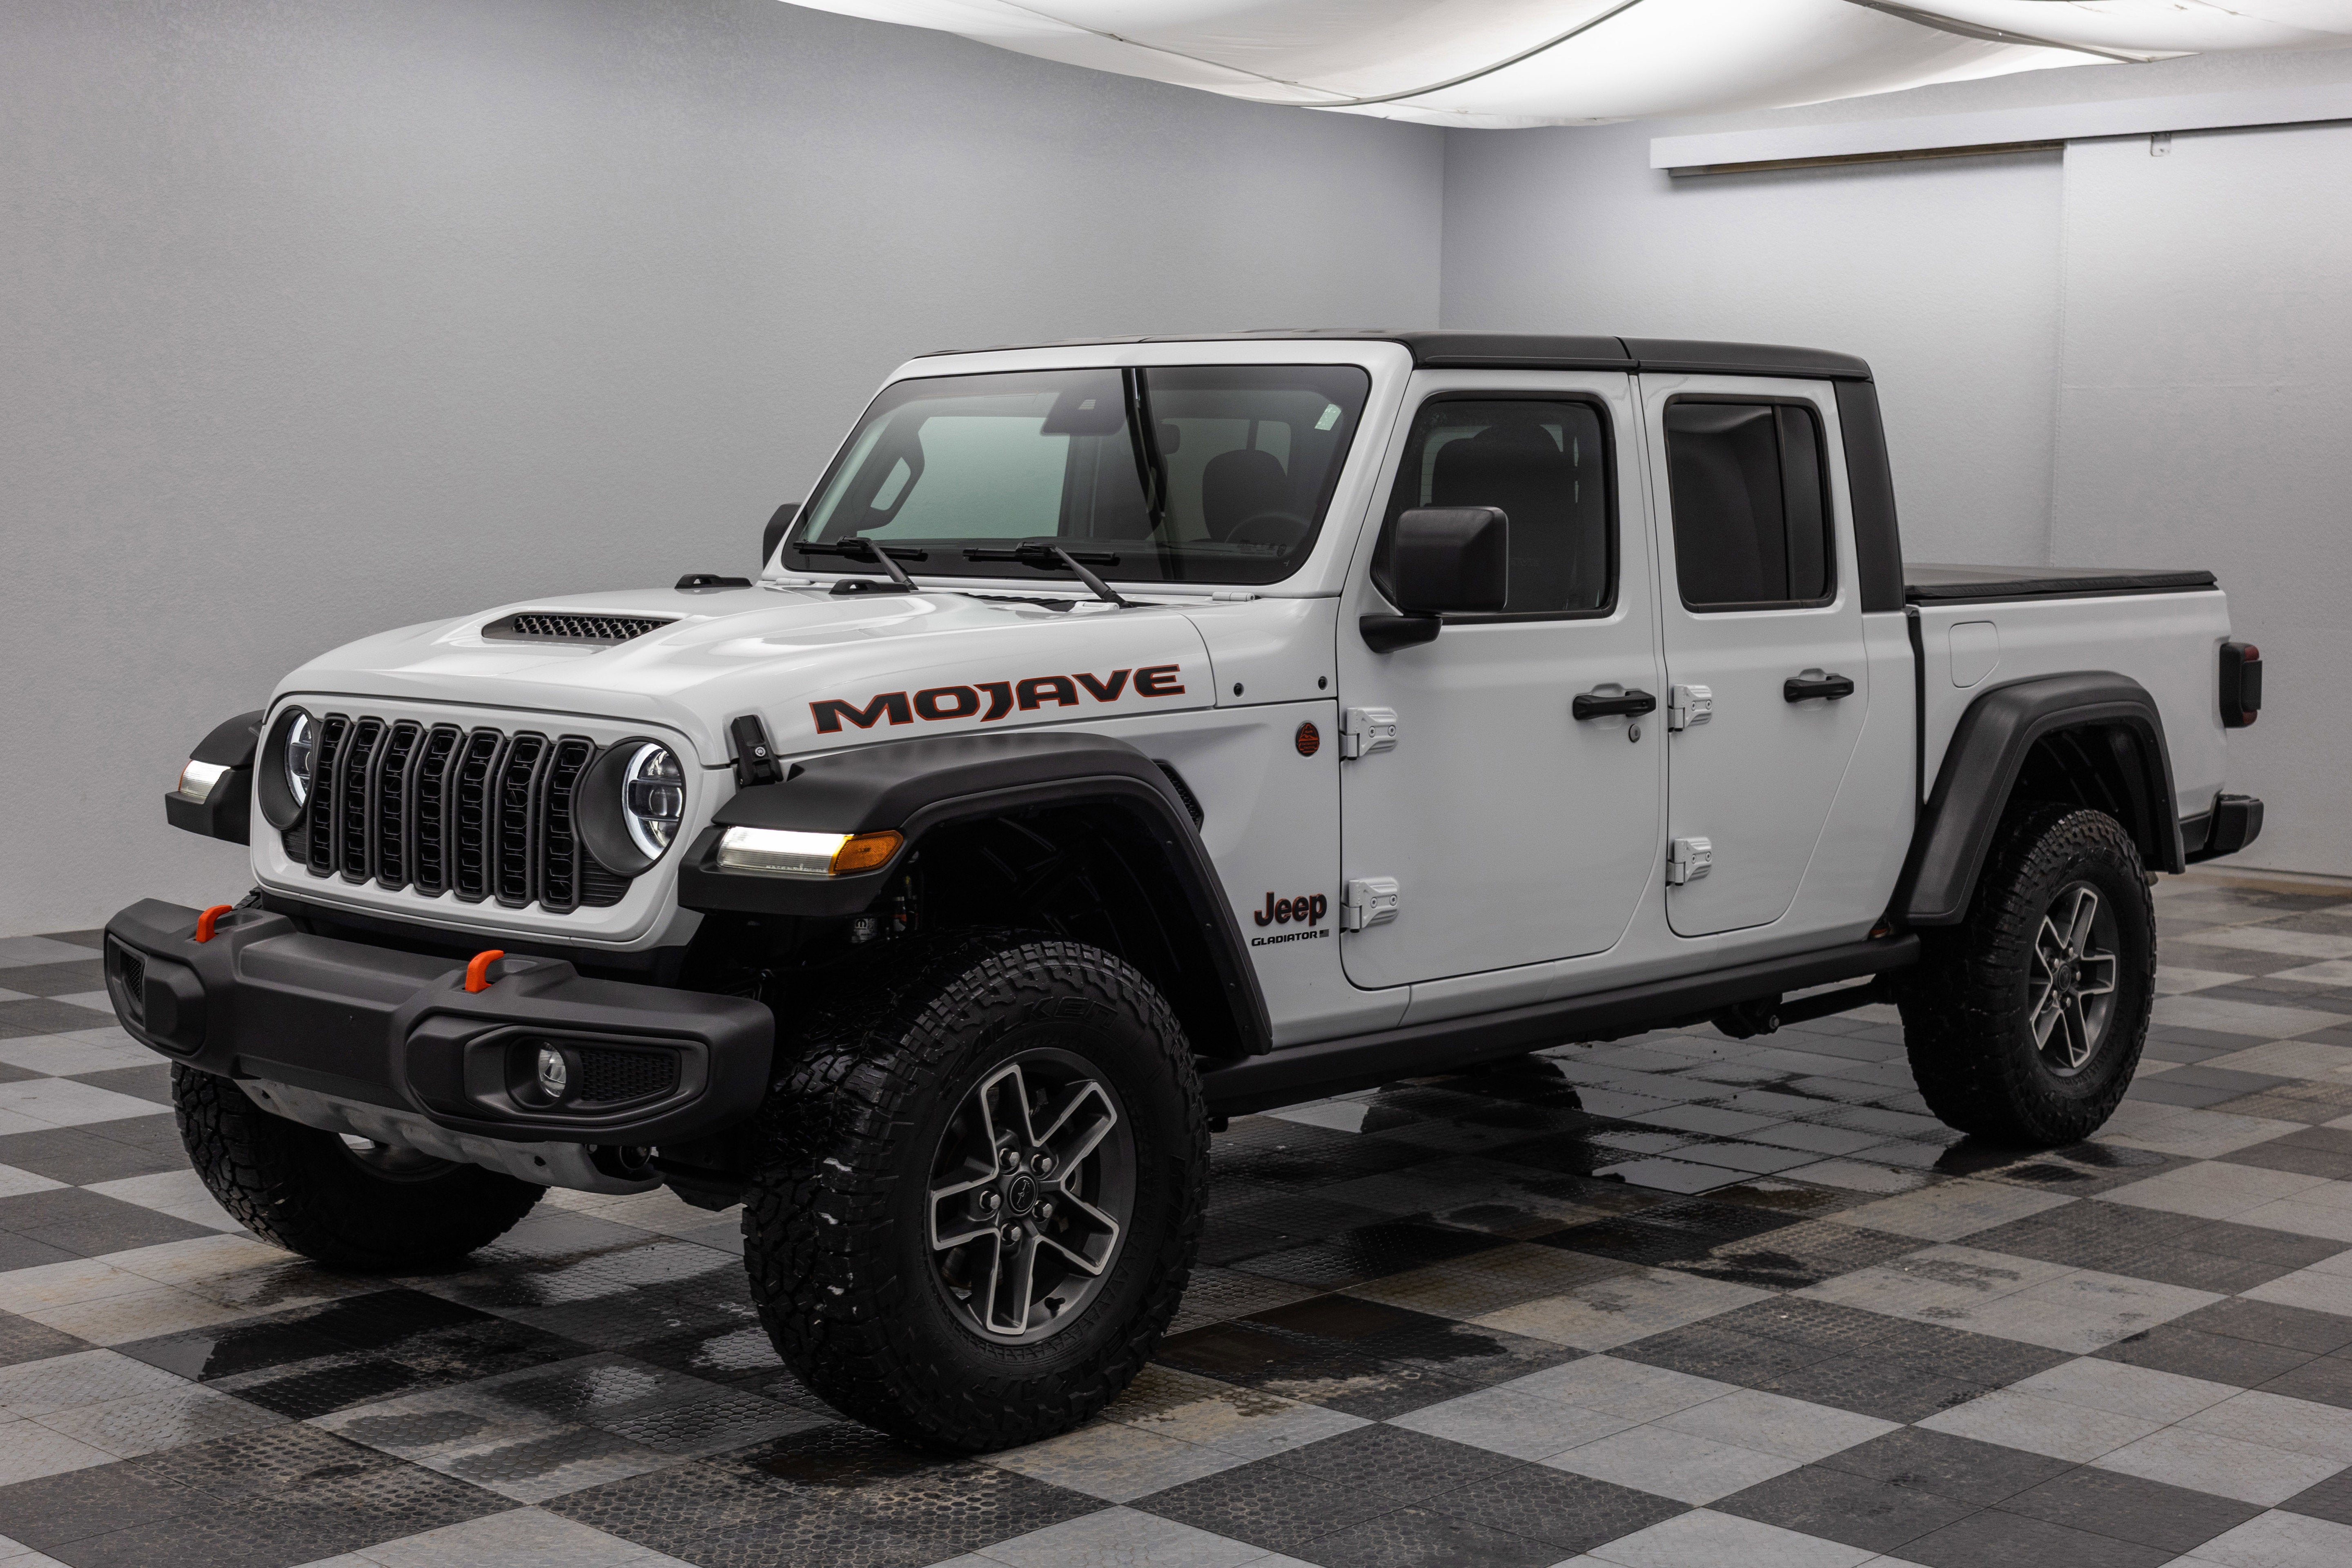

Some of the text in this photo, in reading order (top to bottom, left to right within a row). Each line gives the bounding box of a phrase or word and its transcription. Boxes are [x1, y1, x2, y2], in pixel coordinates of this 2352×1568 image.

[809, 664, 1185, 734] MOJAVE
[1254, 891, 1327, 926] Jeep
[1251, 931, 1317, 946] GLADIATOR
